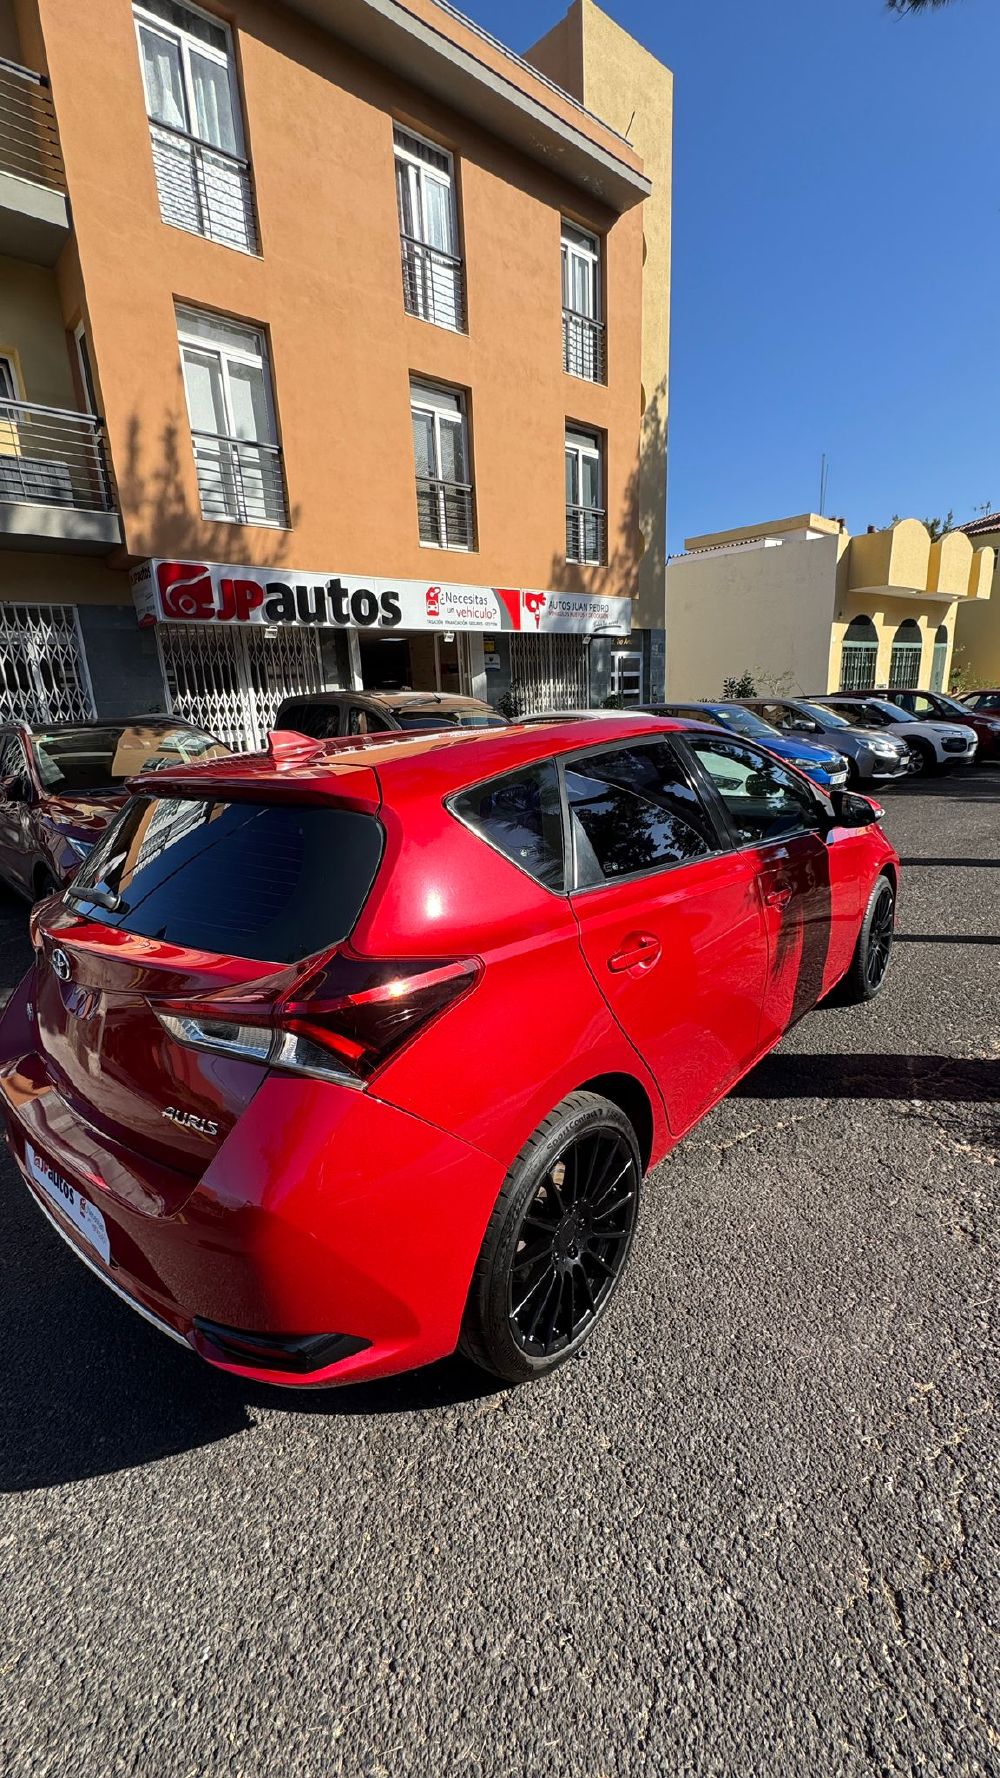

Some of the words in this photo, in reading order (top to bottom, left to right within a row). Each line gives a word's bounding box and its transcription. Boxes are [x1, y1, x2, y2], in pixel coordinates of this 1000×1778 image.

[216, 578, 401, 626] JPautos
[440, 591, 488, 606] ¿Necesitas
[548, 600, 571, 611] AUTOS
[571, 602, 588, 612] JUAN
[589, 603, 610, 613] PEDRO
[161, 1106, 219, 1136] AURIS
